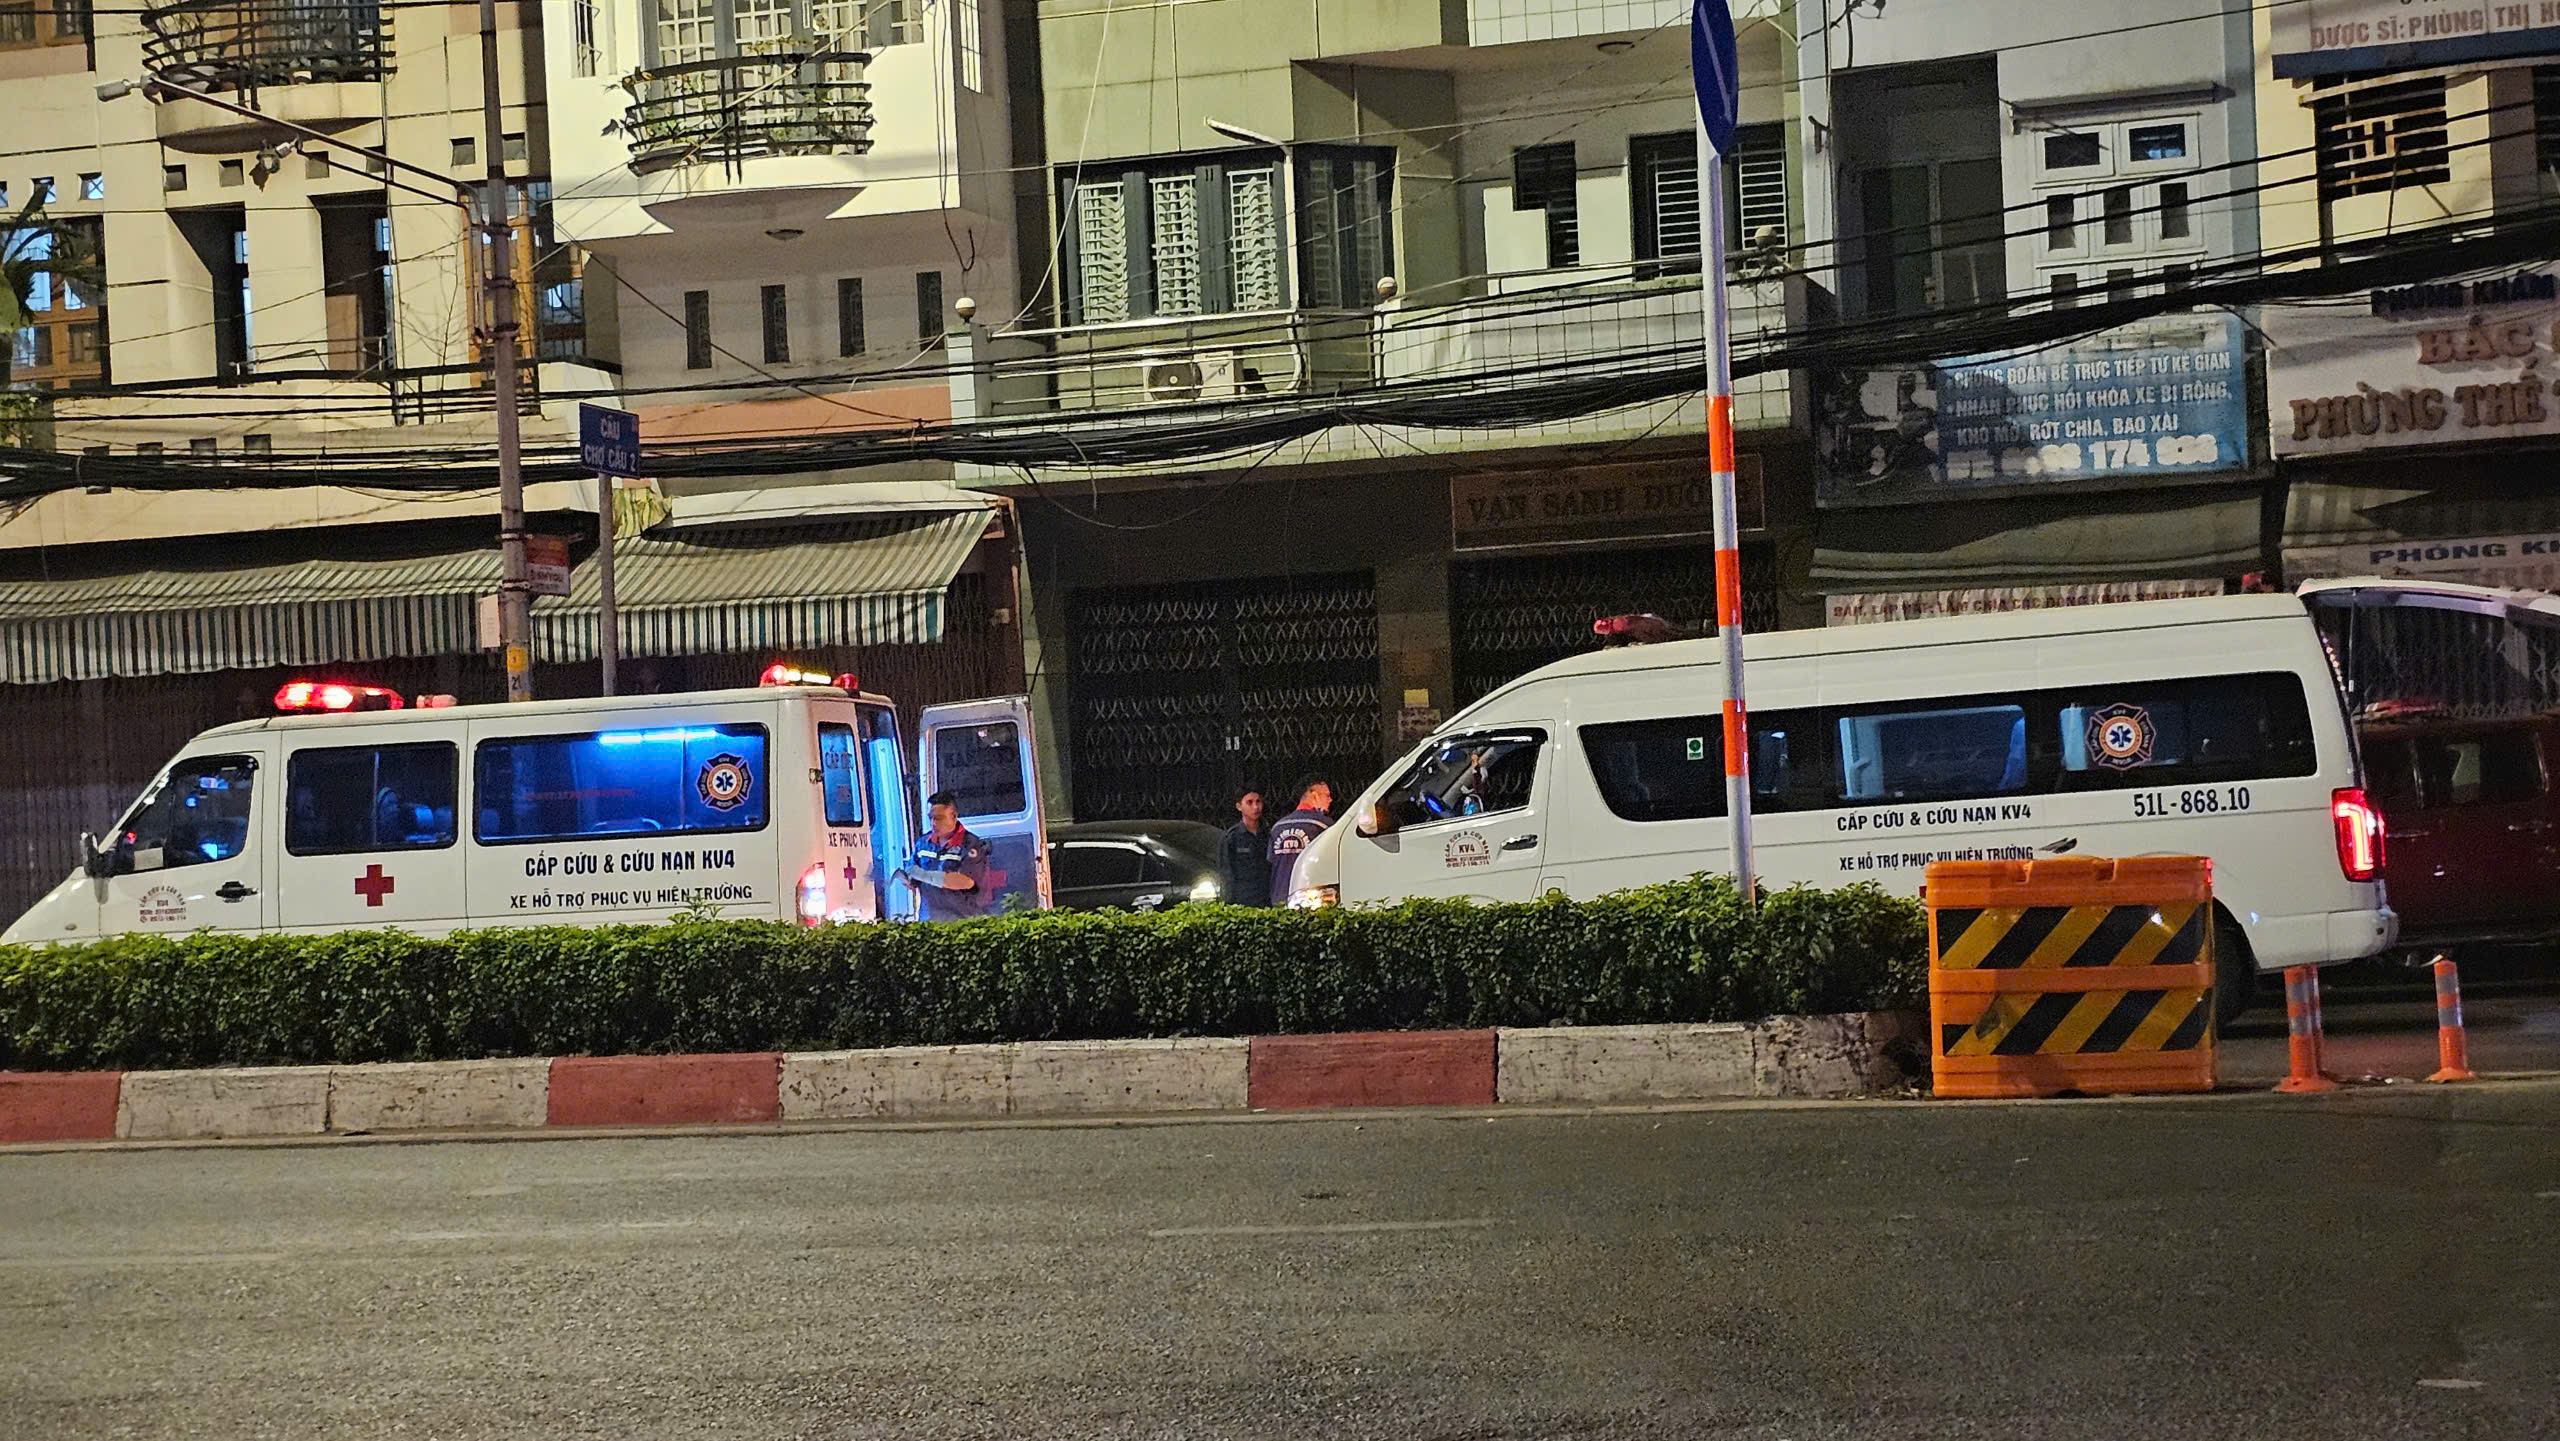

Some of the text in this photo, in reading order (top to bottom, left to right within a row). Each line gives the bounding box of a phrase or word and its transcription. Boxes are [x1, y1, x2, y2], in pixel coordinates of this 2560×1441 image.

[2311, 22, 2370, 49] DƯỢC
[2135, 385, 2156, 404] XE
[2289, 356, 2548, 441] PHÙNG THẾ
[2113, 418, 2146, 435] BAO
[630, 453, 637, 472] 2
[1542, 486, 1625, 517] SANH
[1837, 804, 2032, 831] CẤP CỨU & CỨU NẠN KV4
[828, 833, 838, 847] XE
[1459, 843, 1475, 853] KV4
[525, 850, 558, 877] CẤP
[564, 851, 598, 875] CỨU
[603, 854, 614, 873] &
[621, 849, 655, 873] CỨU
[661, 851, 695, 875] NẠN
[1840, 856, 1854, 871] XE
[1858, 851, 1873, 870] HỖ
[1876, 851, 1899, 871] TRỢ
[510, 881, 753, 910] XE HỖ TRỢ PHỤC VỤ HIỆN TRƯỜNG
